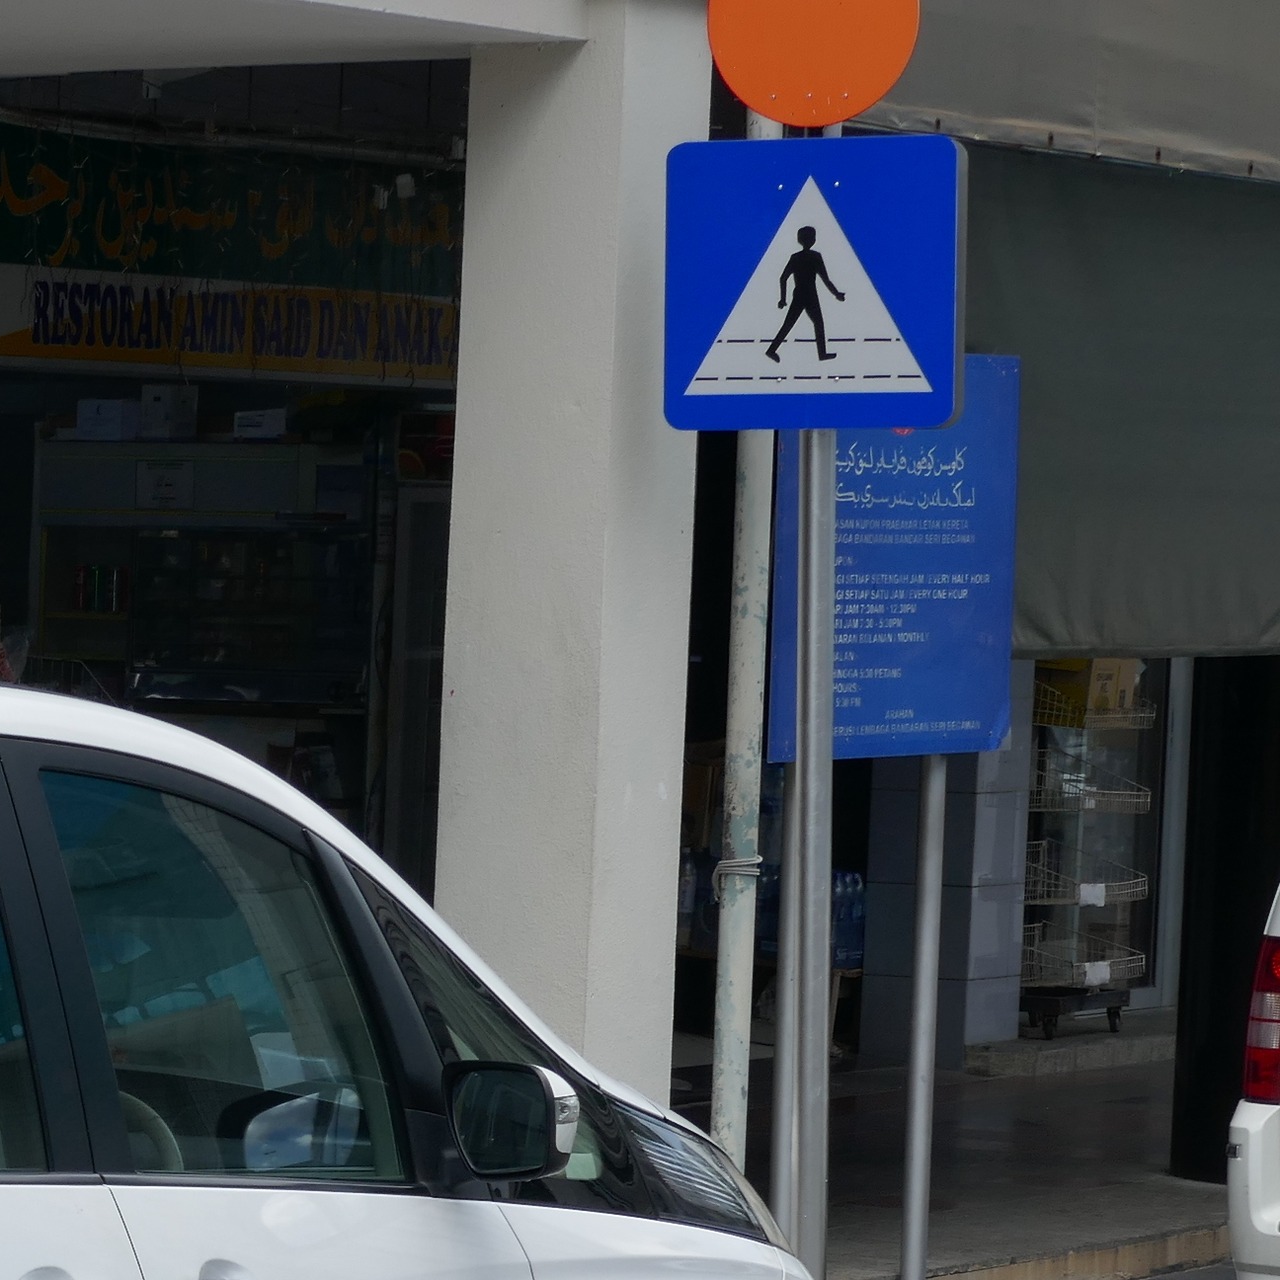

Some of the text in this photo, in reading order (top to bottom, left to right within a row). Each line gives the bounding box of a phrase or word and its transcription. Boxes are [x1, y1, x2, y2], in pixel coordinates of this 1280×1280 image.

[32, 280, 177, 349] RESTORAN
[180, 289, 250, 354] AMIN
[315, 297, 372, 361] DAN
